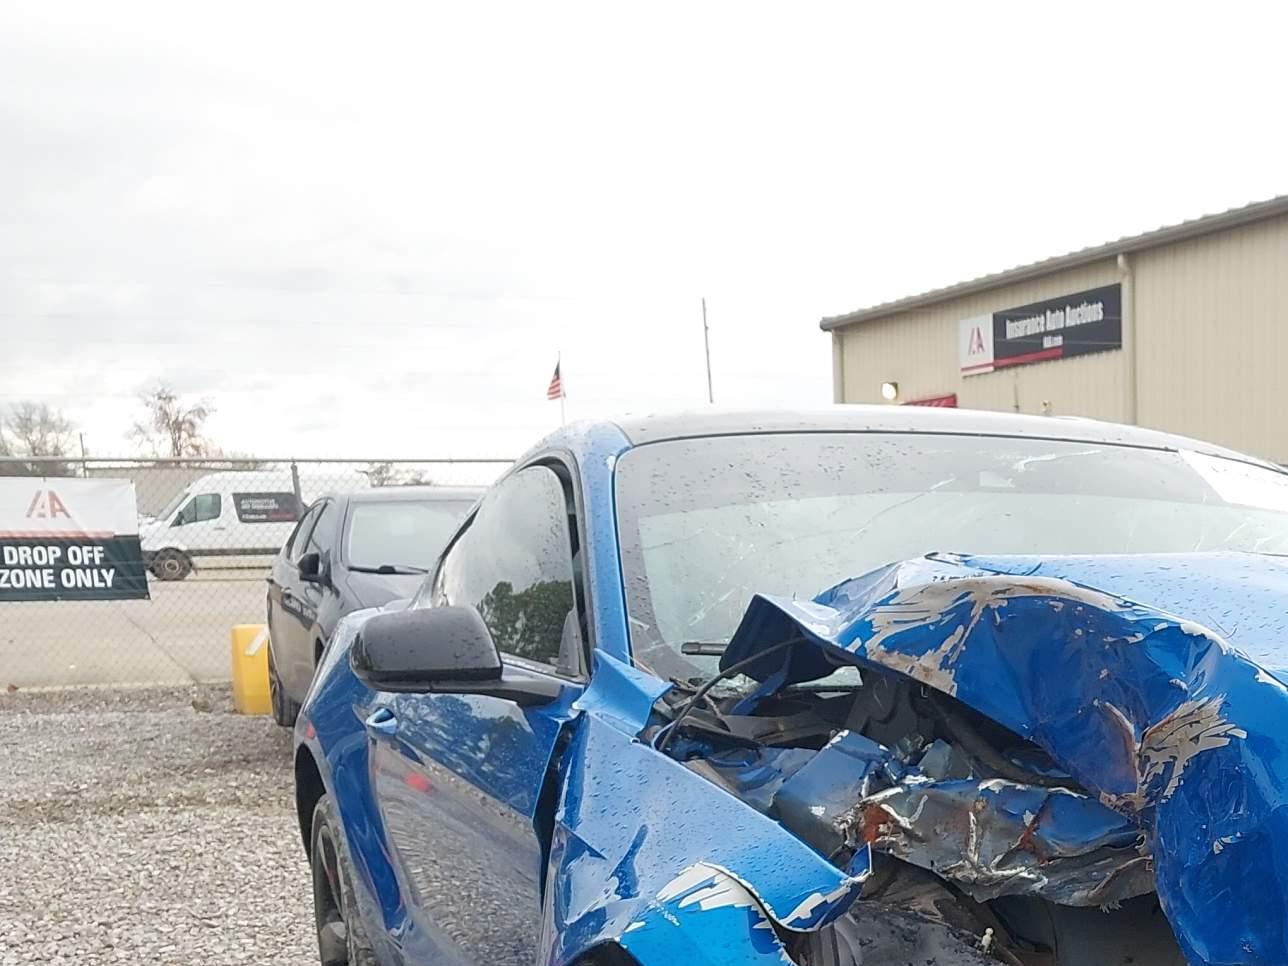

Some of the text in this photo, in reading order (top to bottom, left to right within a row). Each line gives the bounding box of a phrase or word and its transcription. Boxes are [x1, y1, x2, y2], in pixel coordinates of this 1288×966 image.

[1006, 301, 1103, 339] Insurance Auto Auctions
[2, 545, 105, 566] DROP OFF
[0, 568, 116, 589] ZONE ONLY
